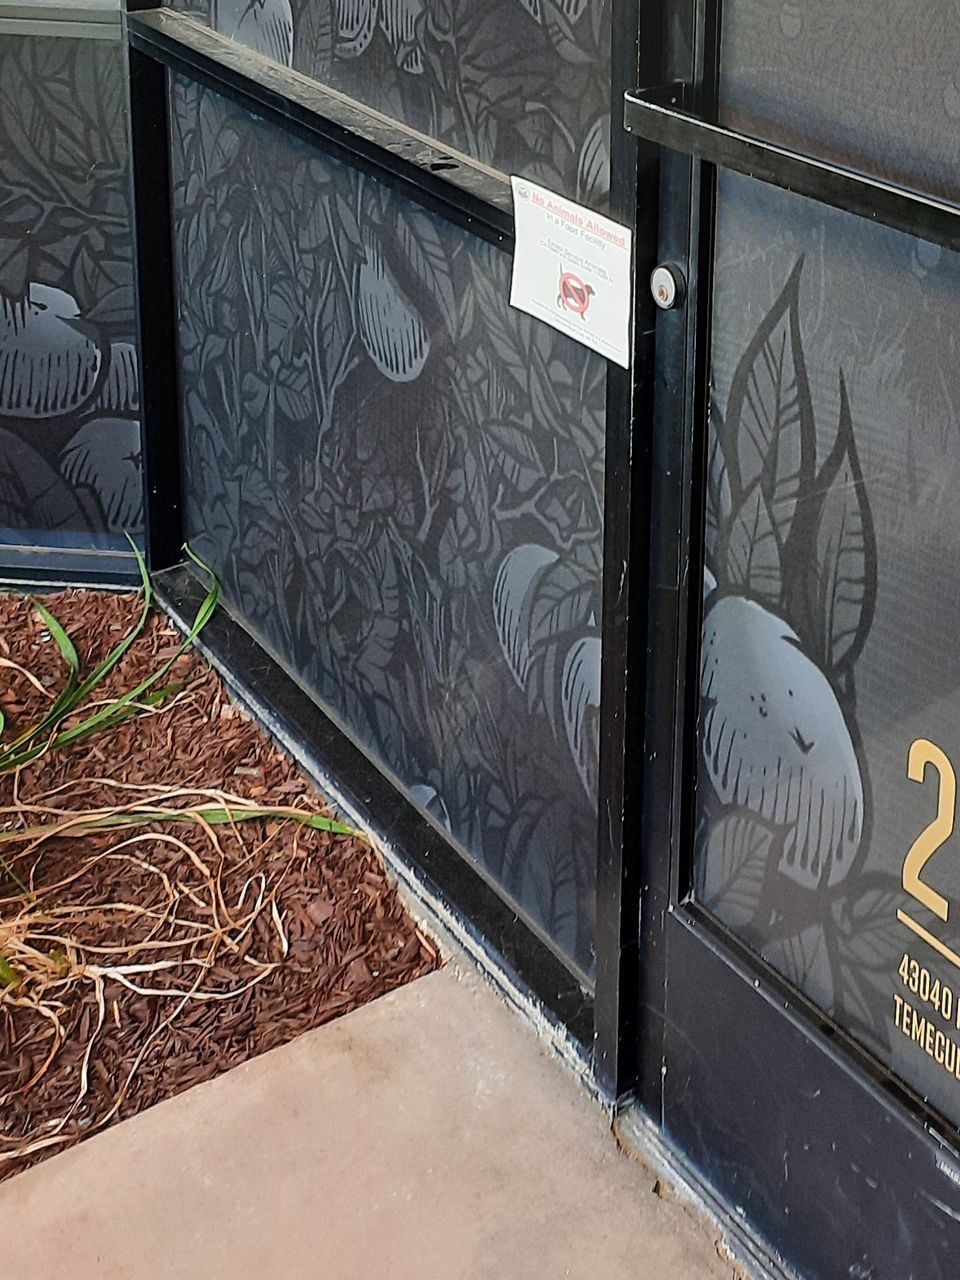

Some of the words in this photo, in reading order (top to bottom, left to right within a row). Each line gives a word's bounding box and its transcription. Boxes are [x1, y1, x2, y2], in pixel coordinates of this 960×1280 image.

[532, 192, 545, 205] No
[547, 200, 583, 226] Animals
[586, 220, 625, 246] Allowed
[560, 219, 579, 236] Food
[580, 230, 606, 250] Facility
[898, 953, 952, 1021] 43040
